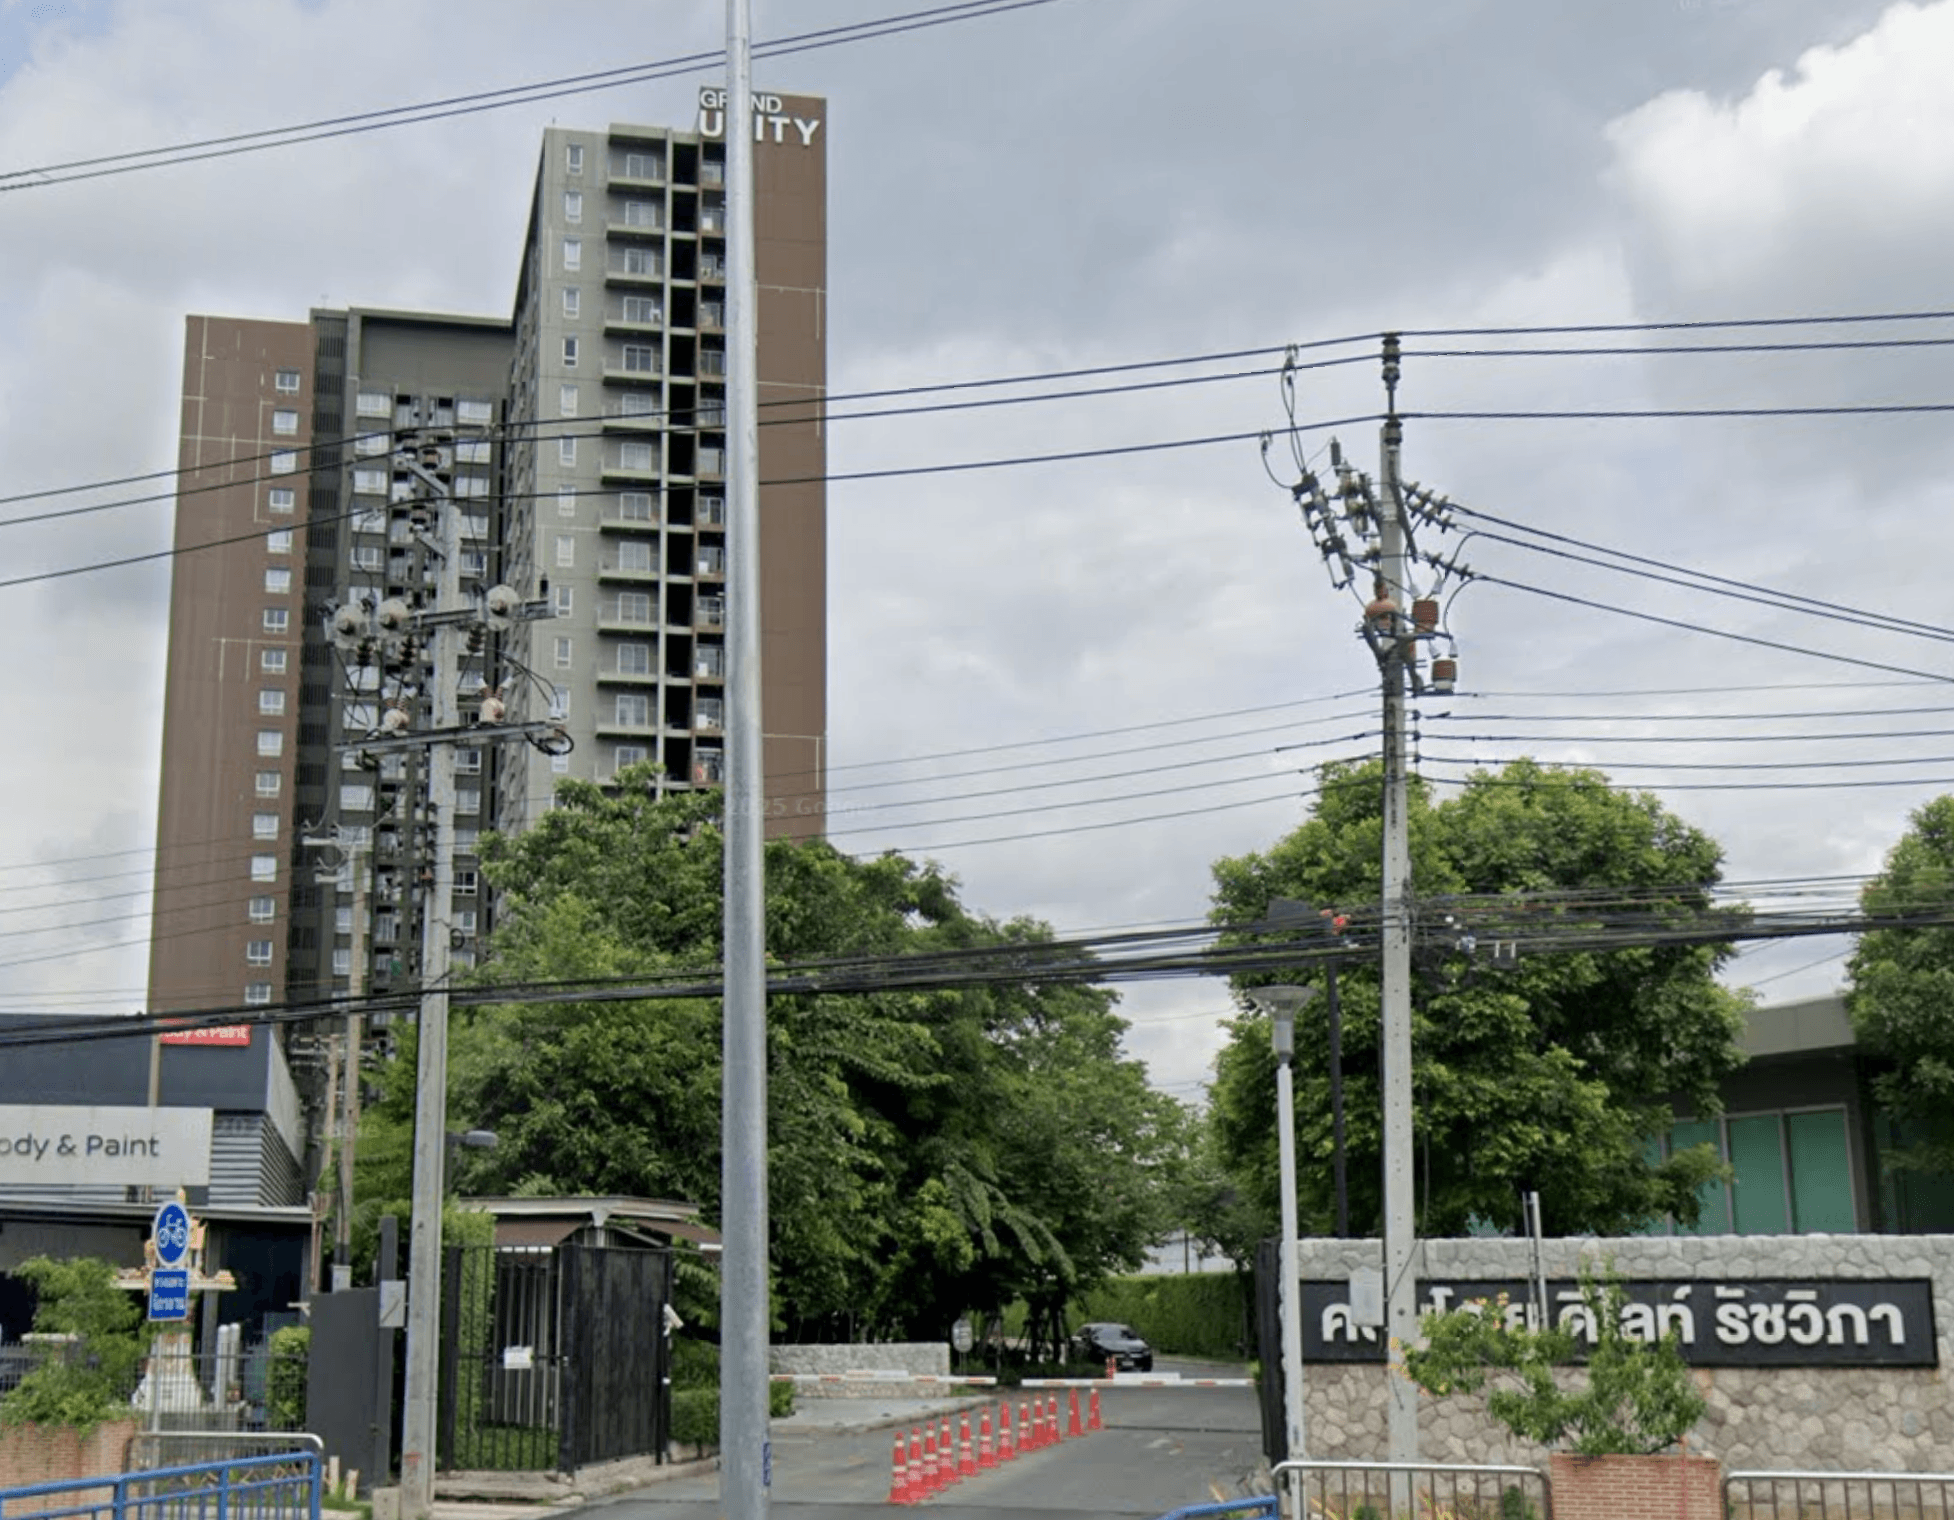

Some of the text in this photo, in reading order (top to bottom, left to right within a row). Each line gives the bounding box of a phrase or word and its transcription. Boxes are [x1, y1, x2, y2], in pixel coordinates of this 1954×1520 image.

[699, 110, 820, 146] UITY
[57, 1134, 77, 1156] &
[86, 1132, 159, 1157] Paint
[1714, 1286, 1906, 1344] รัชวิภา
